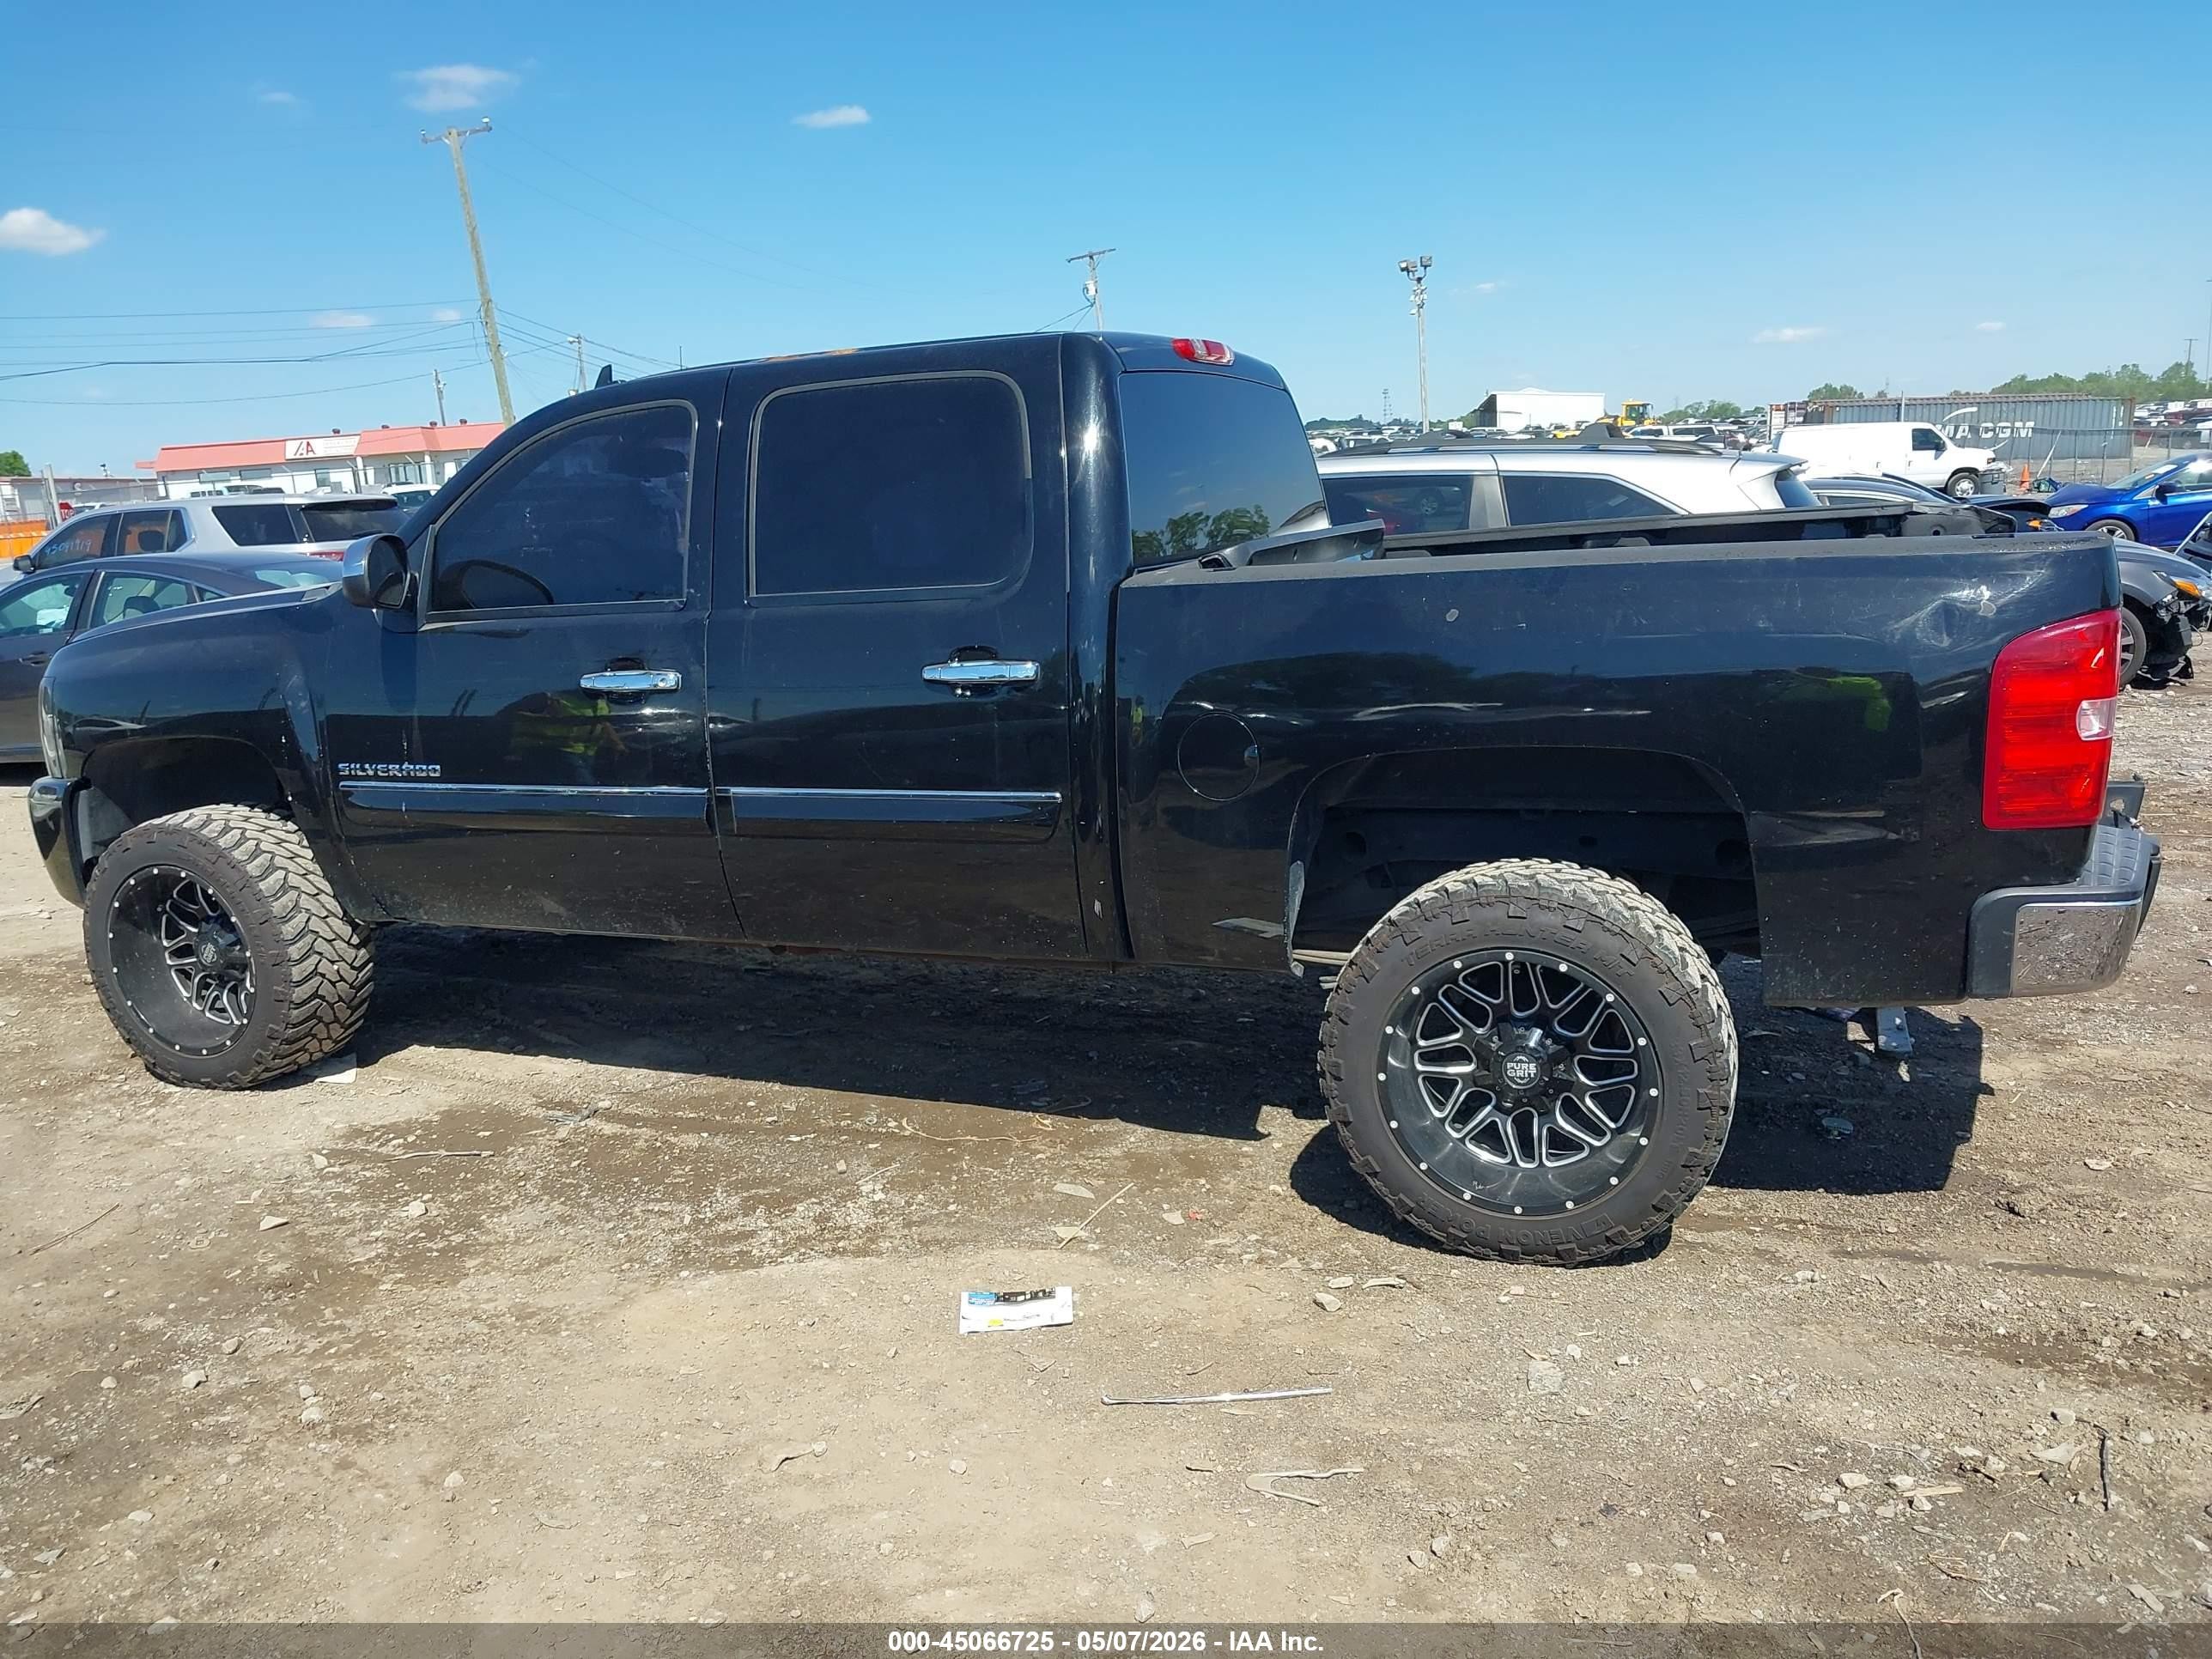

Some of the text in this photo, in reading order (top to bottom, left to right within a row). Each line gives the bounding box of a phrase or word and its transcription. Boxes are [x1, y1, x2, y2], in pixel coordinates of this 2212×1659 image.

[1979, 422, 2035, 439] CGM
[337, 762, 441, 777] SILVERADO
[1401, 929, 1479, 966] TERRA
[1484, 927, 1592, 954] HUNTER
[1506, 1068, 1537, 1078] GRIT
[1497, 1225, 1583, 1245] VENOM
